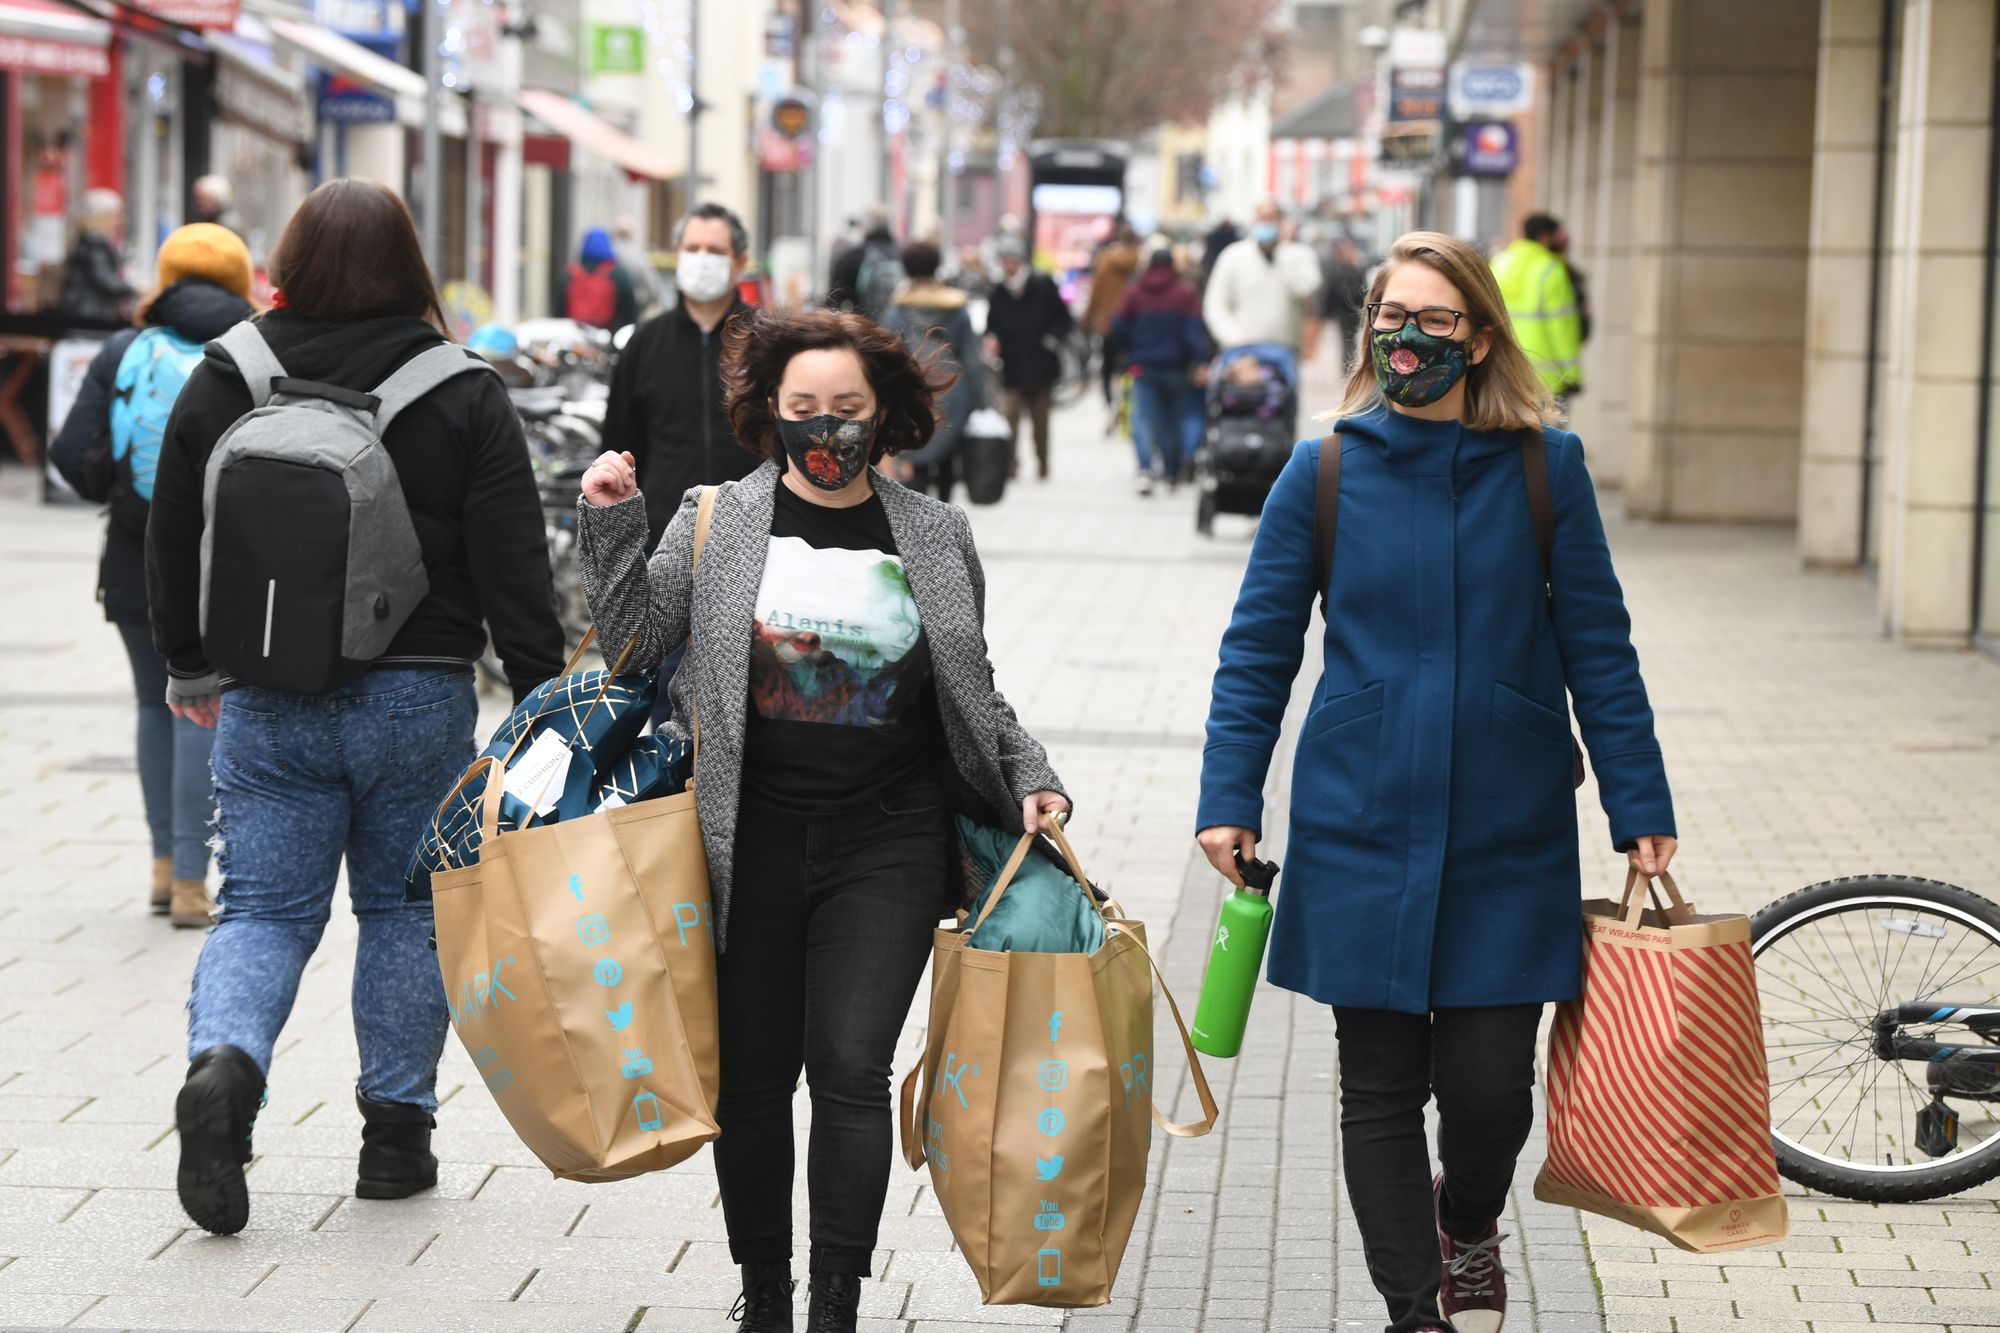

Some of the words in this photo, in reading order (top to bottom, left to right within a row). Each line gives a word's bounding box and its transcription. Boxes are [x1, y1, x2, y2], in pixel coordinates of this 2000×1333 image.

[766, 609, 863, 637] Alanis
[523, 751, 565, 790] CUSHIONS
[1040, 1199, 1059, 1212] You
[1039, 1215, 1060, 1227] Tube
